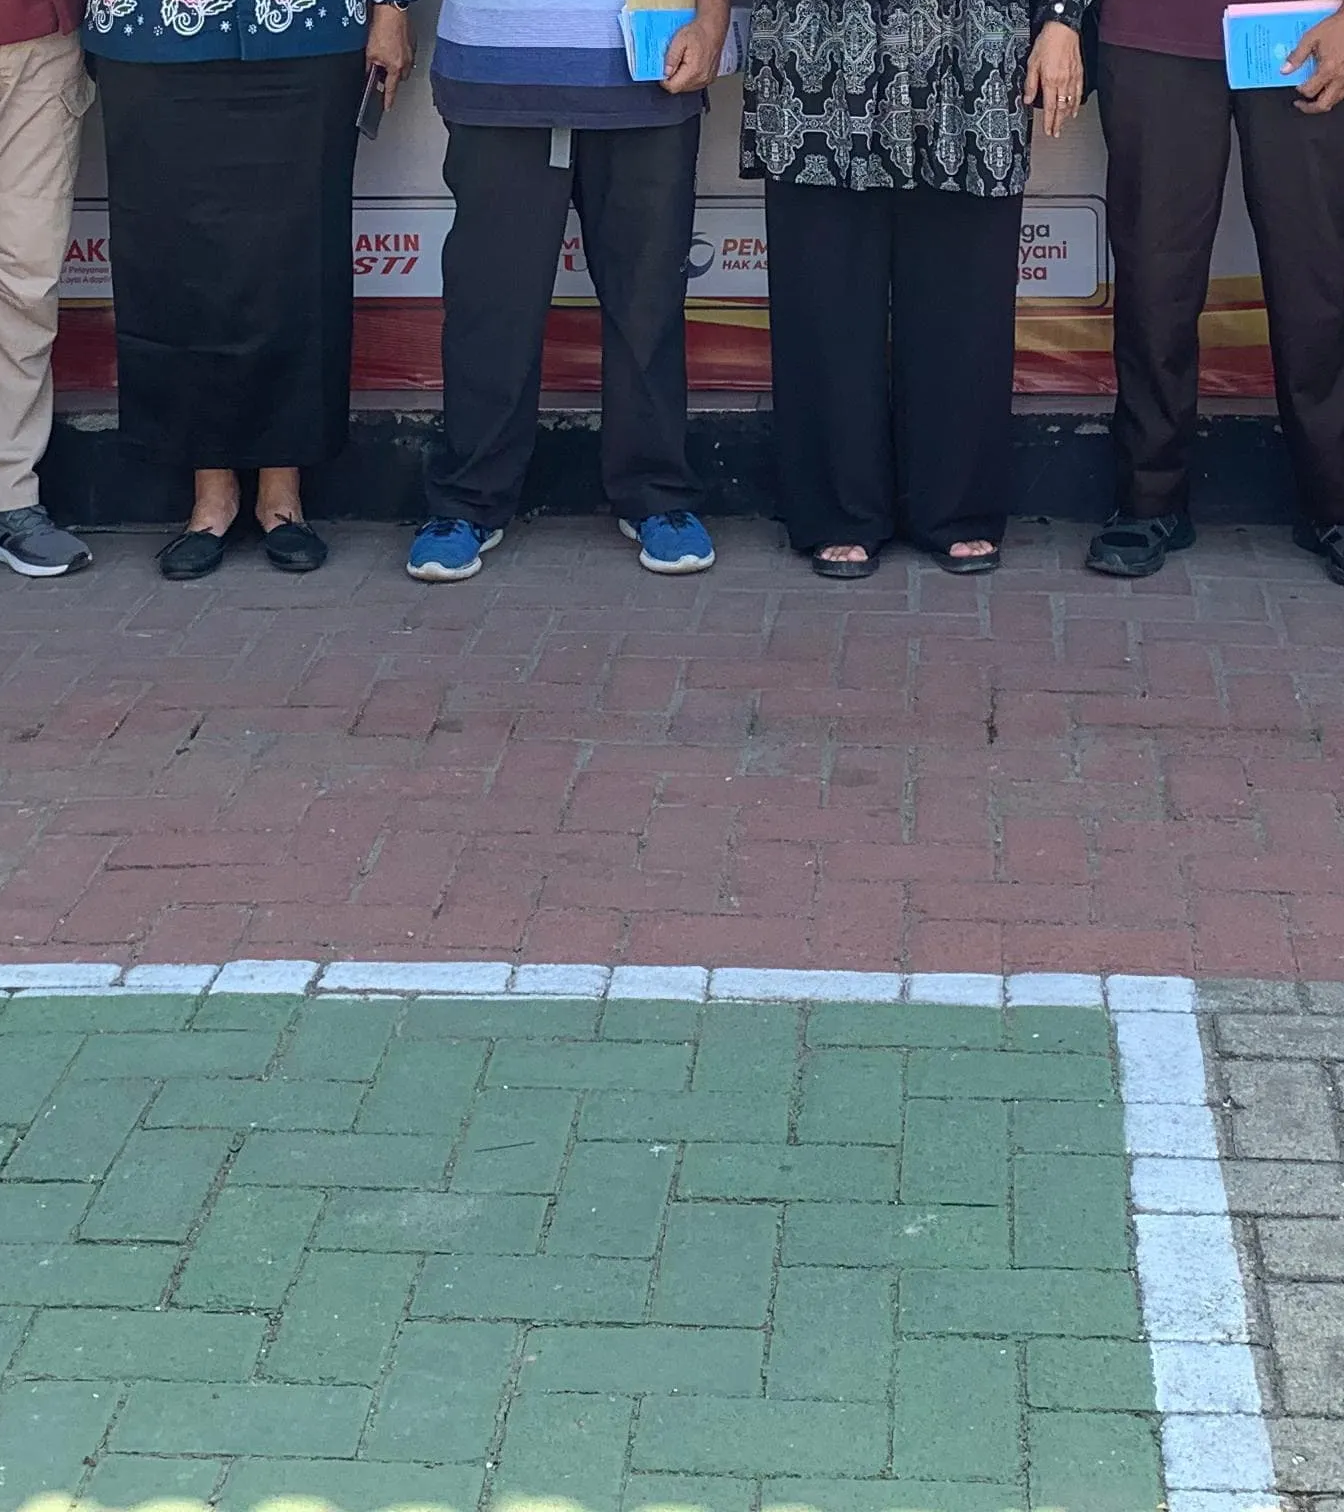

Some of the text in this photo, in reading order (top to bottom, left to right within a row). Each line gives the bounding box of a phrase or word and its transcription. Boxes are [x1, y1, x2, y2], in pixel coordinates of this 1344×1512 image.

[355, 234, 420, 252] AKIN
[1019, 240, 1067, 265] yani
[722, 260, 750, 270] HAK
